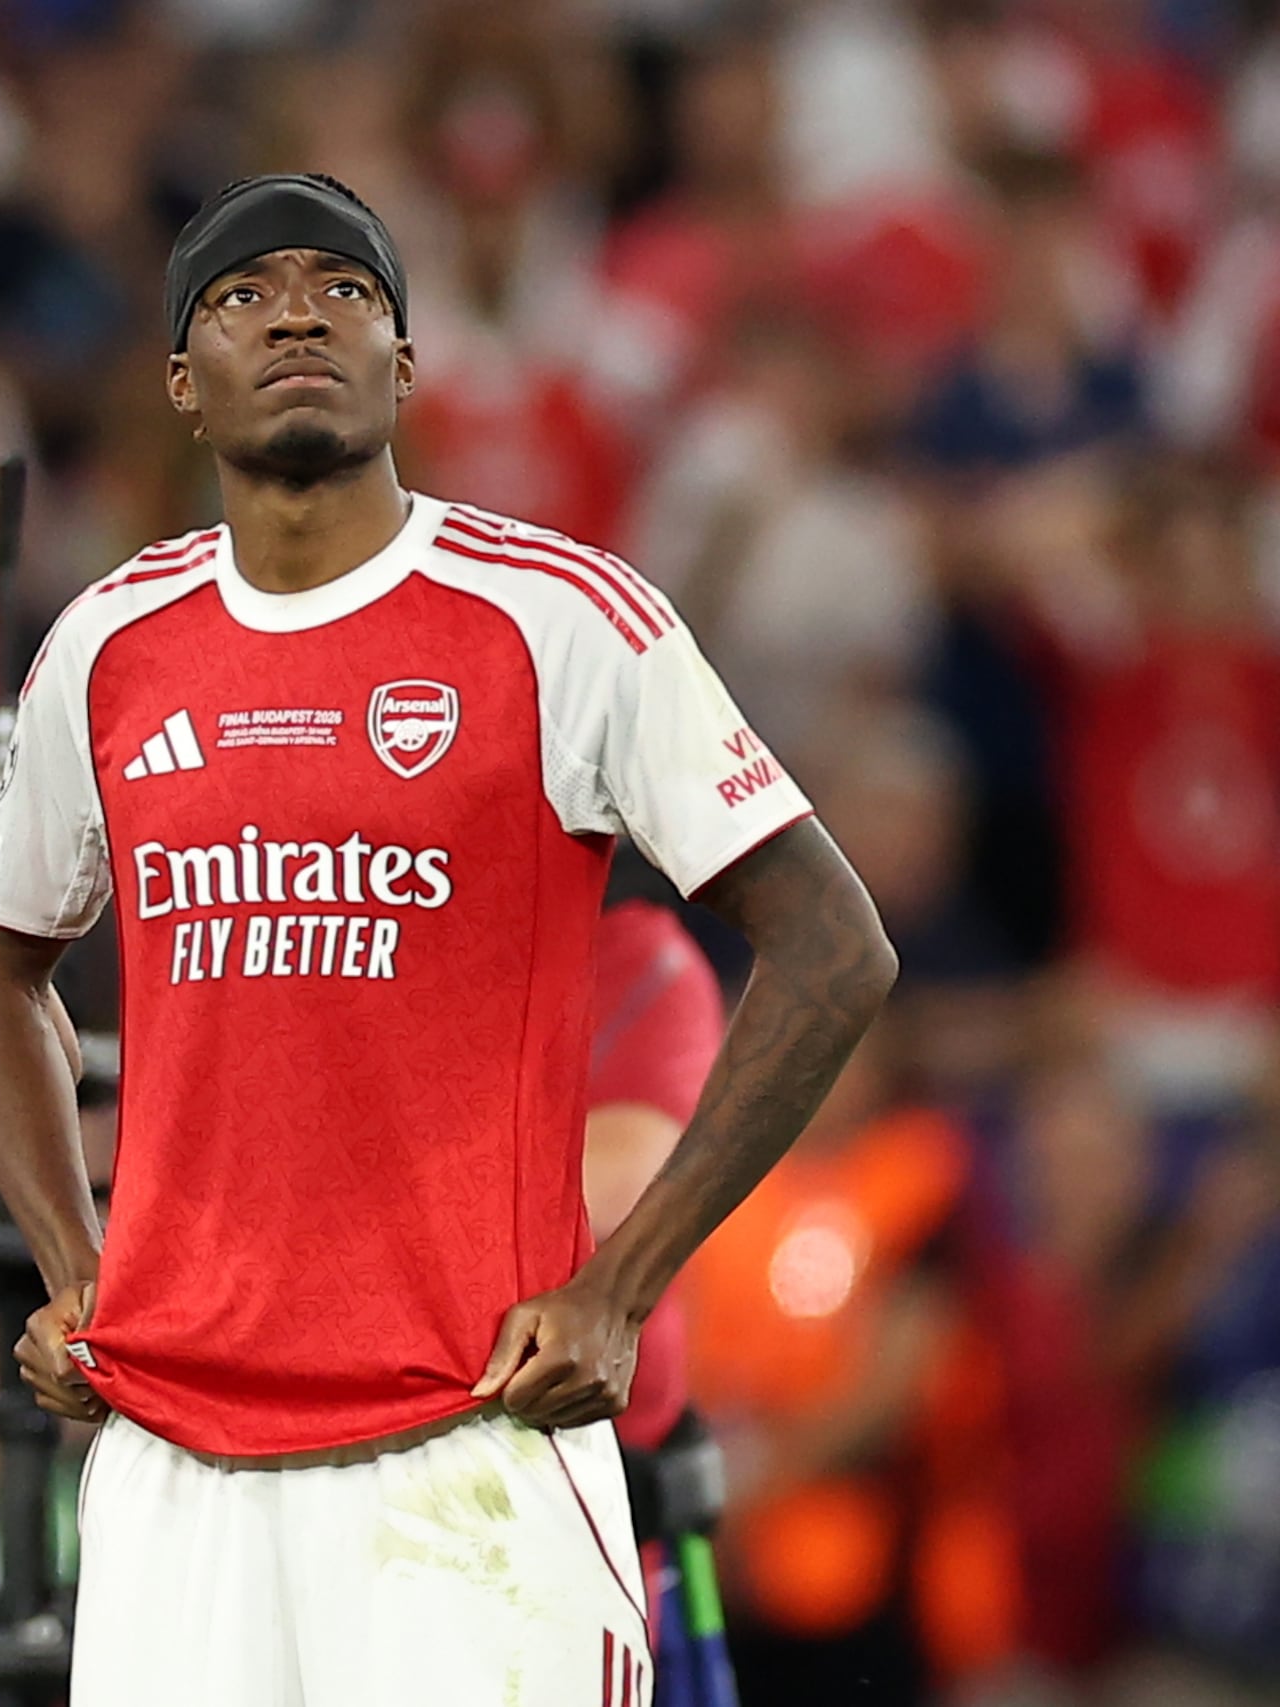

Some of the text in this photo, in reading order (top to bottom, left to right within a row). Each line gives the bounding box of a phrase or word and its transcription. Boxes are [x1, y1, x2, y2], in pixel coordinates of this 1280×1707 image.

[218, 709, 342, 728] FINAL BUDAPEST 2026
[382, 697, 445, 713] Arsenal
[133, 824, 453, 920] Emirates
[170, 915, 400, 985] FLY BETTER
